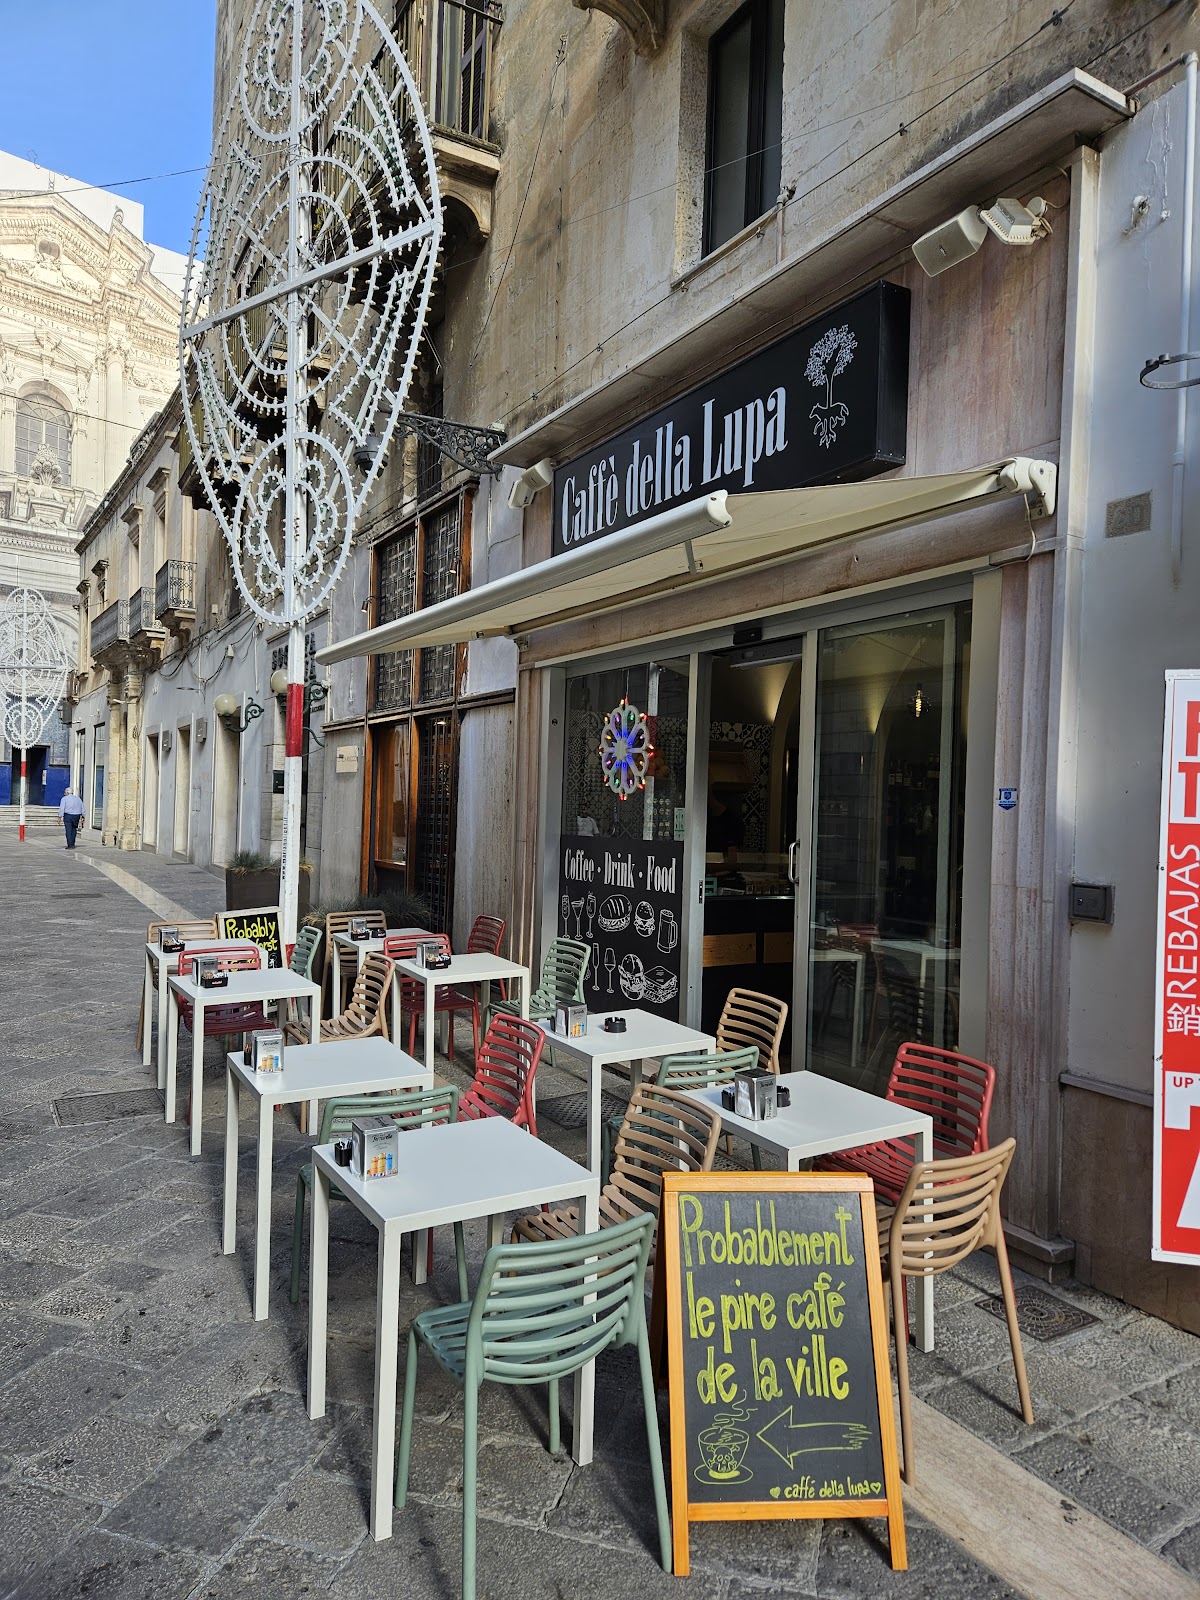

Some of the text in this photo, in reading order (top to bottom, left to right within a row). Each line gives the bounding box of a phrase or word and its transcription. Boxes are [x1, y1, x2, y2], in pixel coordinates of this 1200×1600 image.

[561, 386, 788, 546] Caffè della Lupa
[564, 848, 676, 894] Coffee Drink Food
[226, 917, 276, 939] Probably
[1167, 844, 1200, 999] REBAJAS
[1173, 1076, 1194, 1088] UP
[679, 1195, 854, 1267] Probablement
[686, 1271, 846, 1353] le pire café
[697, 1334, 849, 1404] de la ville
[819, 1479, 845, 1498] della
[847, 1476, 870, 1498] lupa
